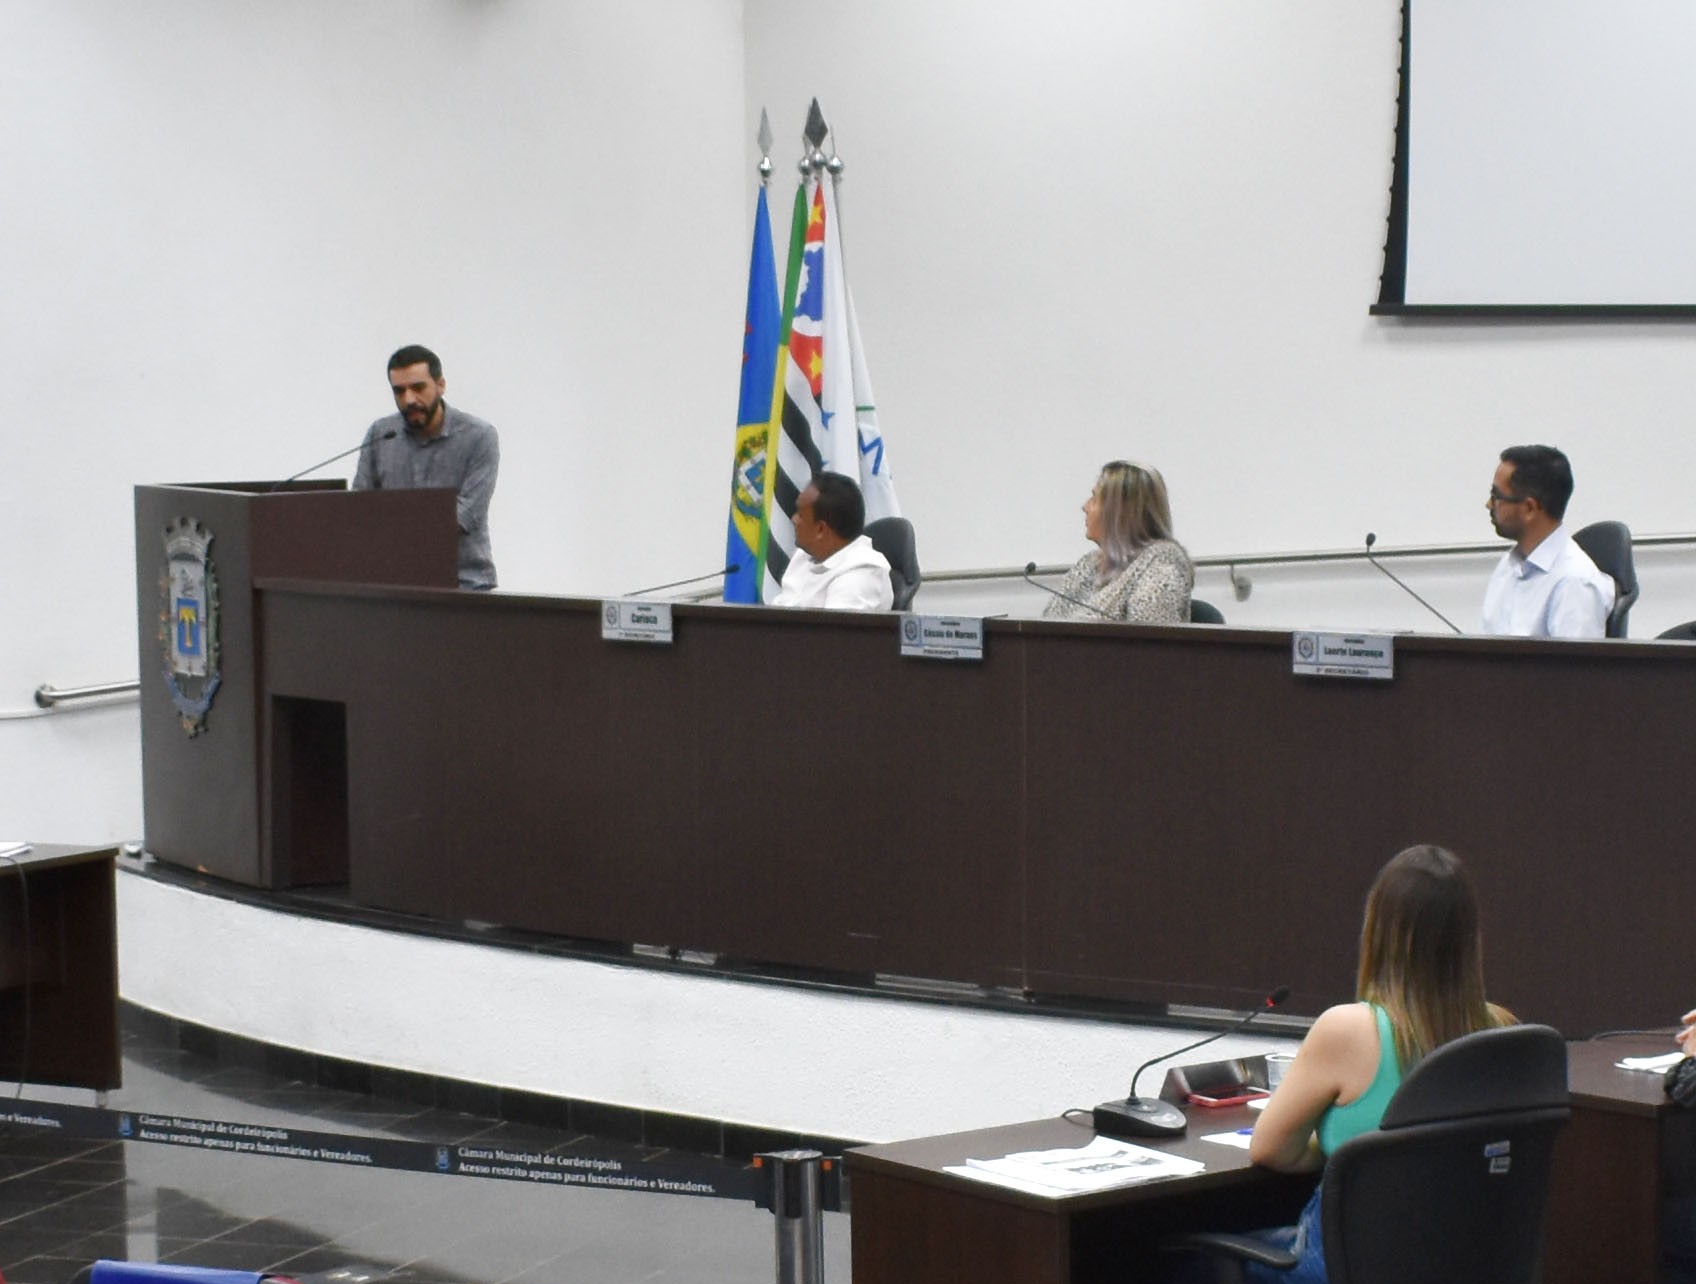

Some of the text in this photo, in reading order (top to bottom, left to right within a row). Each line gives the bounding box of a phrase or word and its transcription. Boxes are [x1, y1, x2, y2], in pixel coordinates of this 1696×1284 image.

[139, 1114, 288, 1140] Câmara Municipal de Cordeirópolis
[140, 1128, 169, 1141] Acesso
[170, 1131, 202, 1144] restrito
[203, 1137, 234, 1150] apenas
[235, 1139, 255, 1151] para
[256, 1142, 311, 1157] funcionários
[312, 1149, 319, 1157] e
[458, 1147, 622, 1171] Câmara Municipal de Cordeirópolis
[458, 1162, 716, 1194] Acesso restrito apenas para funcionários e Vereadores.
